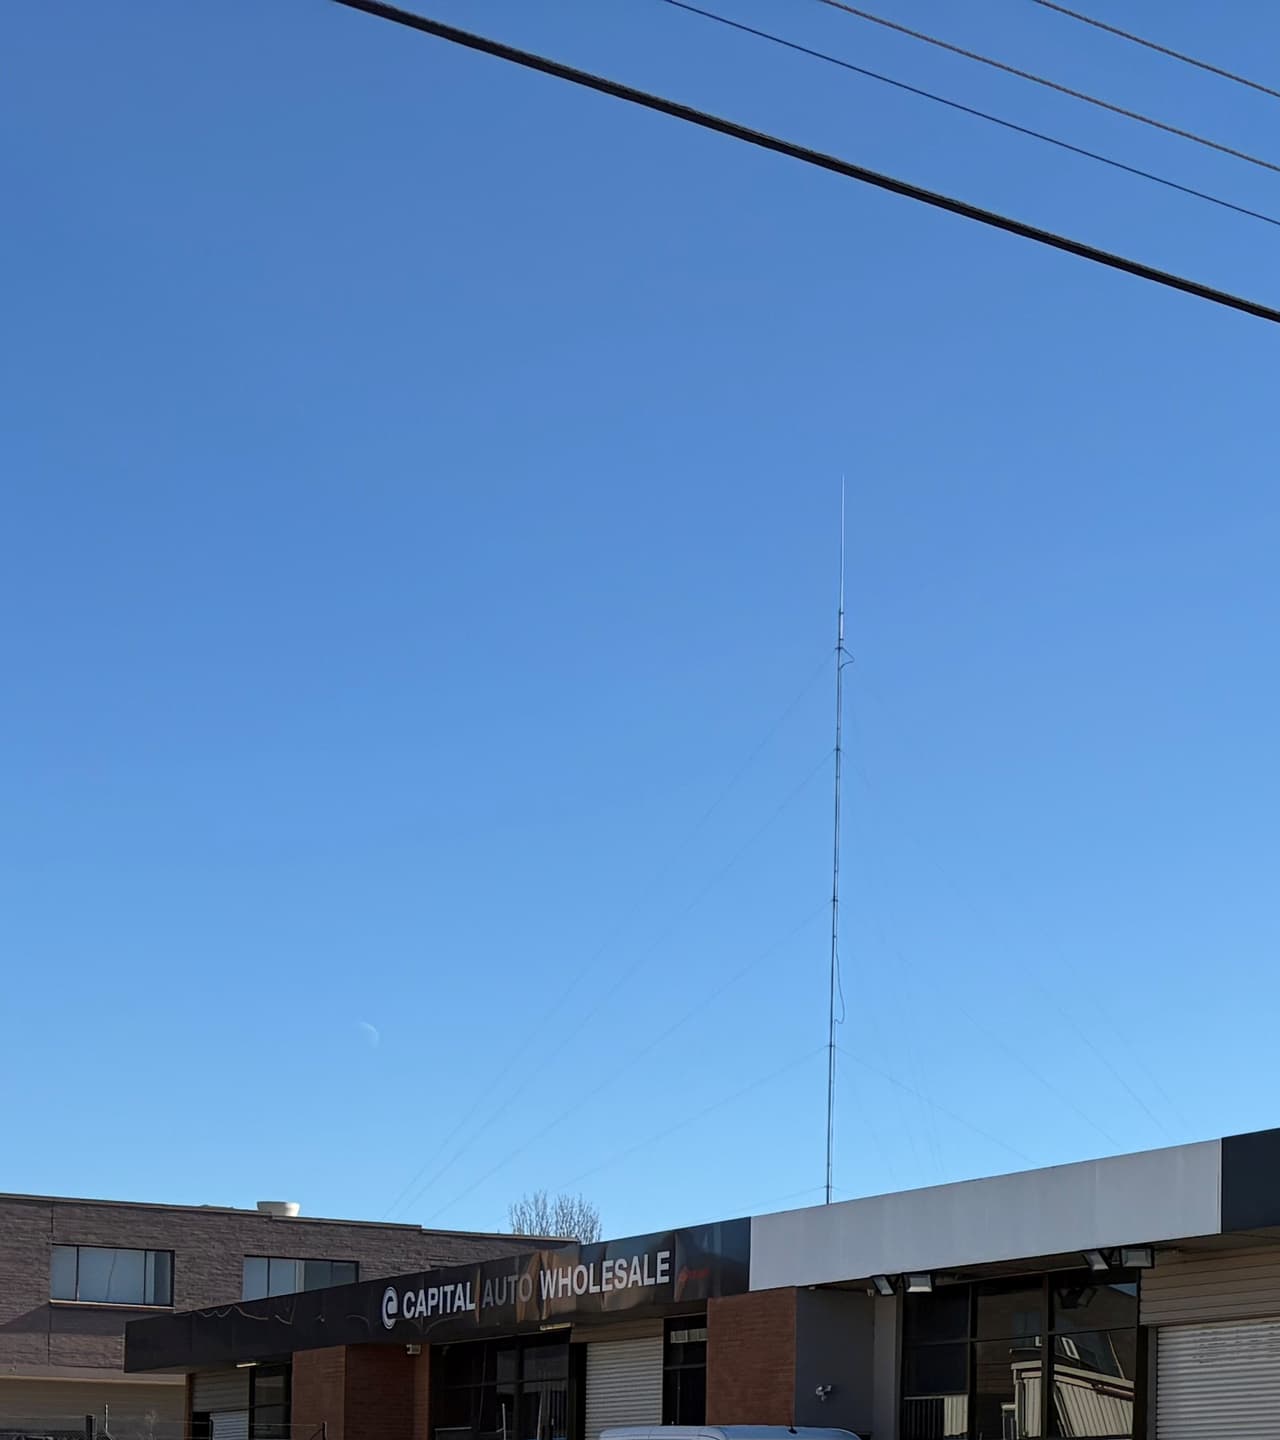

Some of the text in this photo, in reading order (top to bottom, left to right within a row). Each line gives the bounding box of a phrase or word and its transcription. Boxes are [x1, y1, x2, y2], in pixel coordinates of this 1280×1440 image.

[402, 1250, 671, 1319] CAPITAL AUTO WHOLESALE
